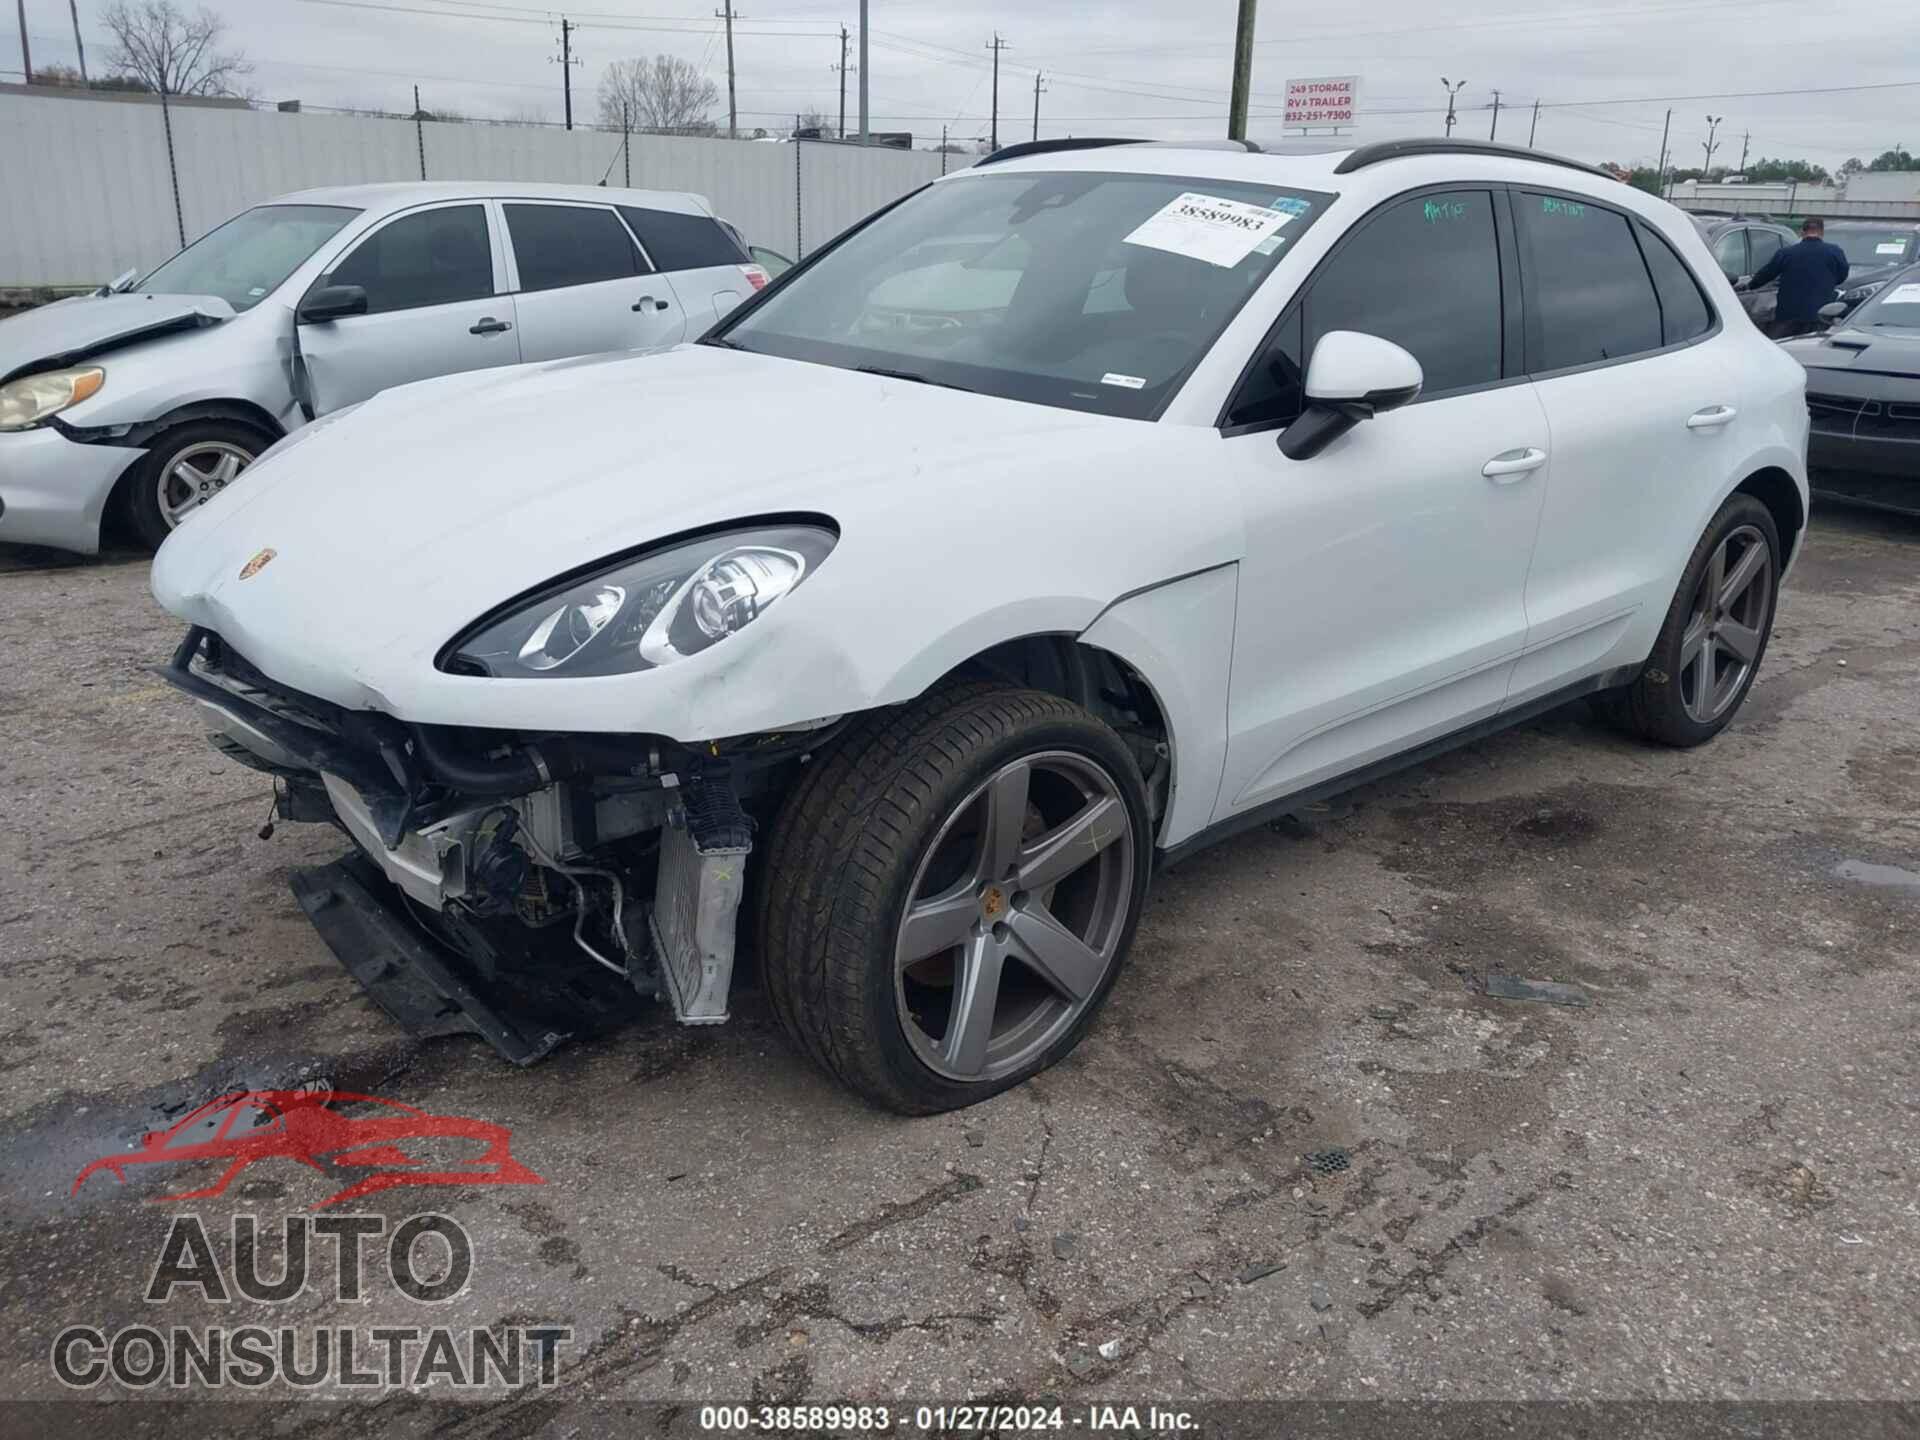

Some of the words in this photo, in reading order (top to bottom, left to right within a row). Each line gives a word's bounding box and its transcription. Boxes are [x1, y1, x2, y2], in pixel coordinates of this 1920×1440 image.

[1290, 85, 1306, 94] 249
[1308, 83, 1351, 94] STORAGE
[1287, 98, 1301, 108] RV
[1308, 96, 1351, 107] TRAILER
[1285, 110, 1352, 121] 832-251-7300
[1172, 204, 1265, 231] 38589983
